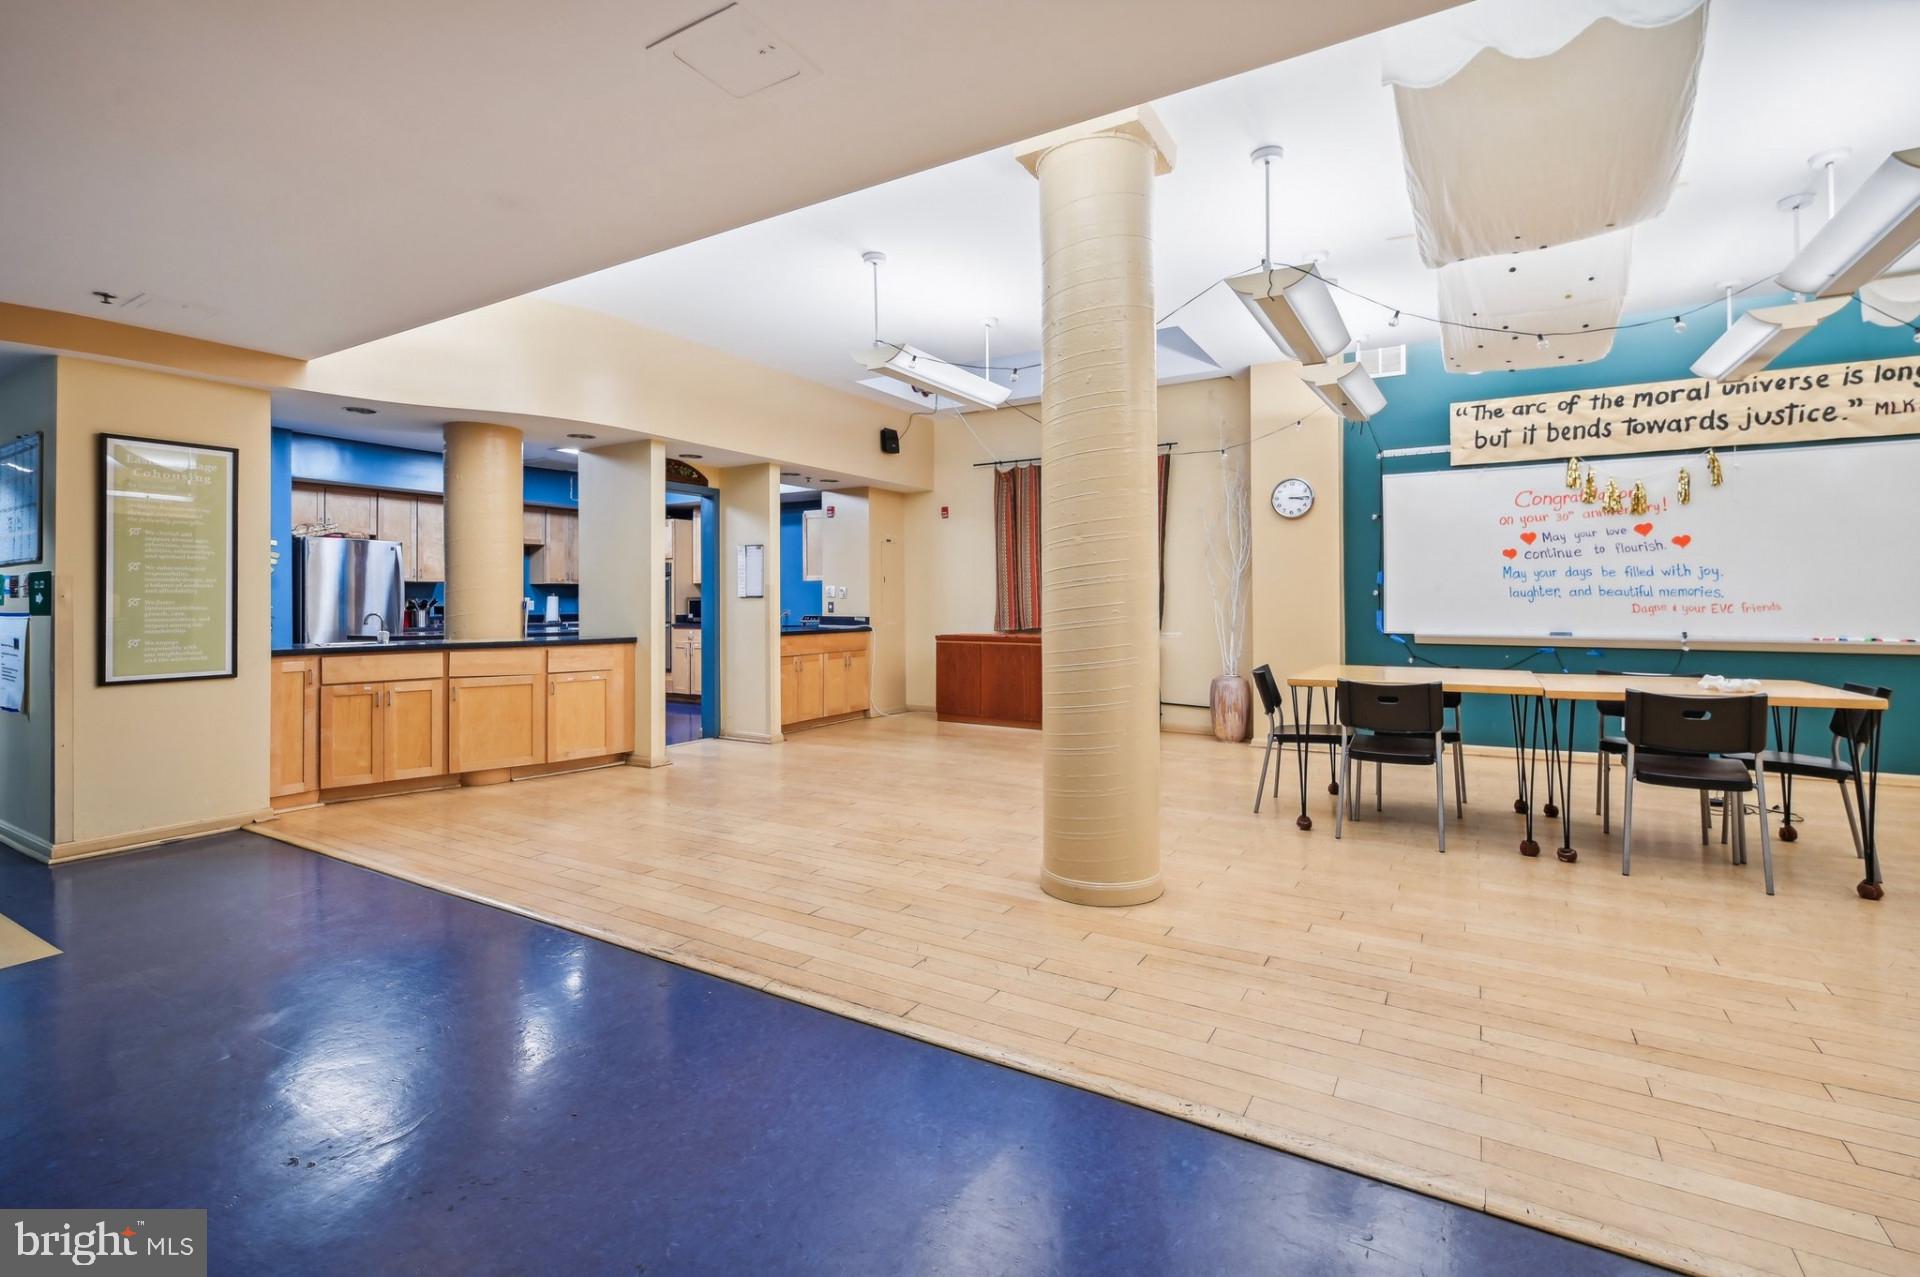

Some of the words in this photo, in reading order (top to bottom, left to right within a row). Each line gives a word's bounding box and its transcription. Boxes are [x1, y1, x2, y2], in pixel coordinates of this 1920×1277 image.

[1511, 401, 1547, 416] arc
[1557, 394, 1581, 414] of
[1590, 393, 1625, 410] the
[1632, 381, 1710, 408] moral
[1721, 375, 1830, 396] universe
[1842, 366, 1864, 386] is
[1475, 427, 1512, 449] but
[1522, 423, 1537, 445] it
[1546, 417, 1612, 442] bends
[1499, 514, 1514, 526] on
[1519, 513, 1549, 528] your
[1541, 532, 1567, 544] May
[1574, 530, 1598, 543] your
[1605, 528, 1628, 537] love
[1523, 548, 1582, 560] continue
[1594, 544, 1606, 555] to
[1502, 565, 1528, 582] May
[1533, 567, 1558, 582] your
[1565, 565, 1593, 581] days
[1600, 565, 1617, 578] be
[1624, 565, 1655, 578] filled
[1661, 563, 1691, 577] with
[1568, 585, 1593, 597] and
[1598, 585, 1654, 598] beautiful
[1681, 604, 1706, 616] your
[1711, 603, 1735, 614] EVC
[1740, 601, 1783, 613] friends
